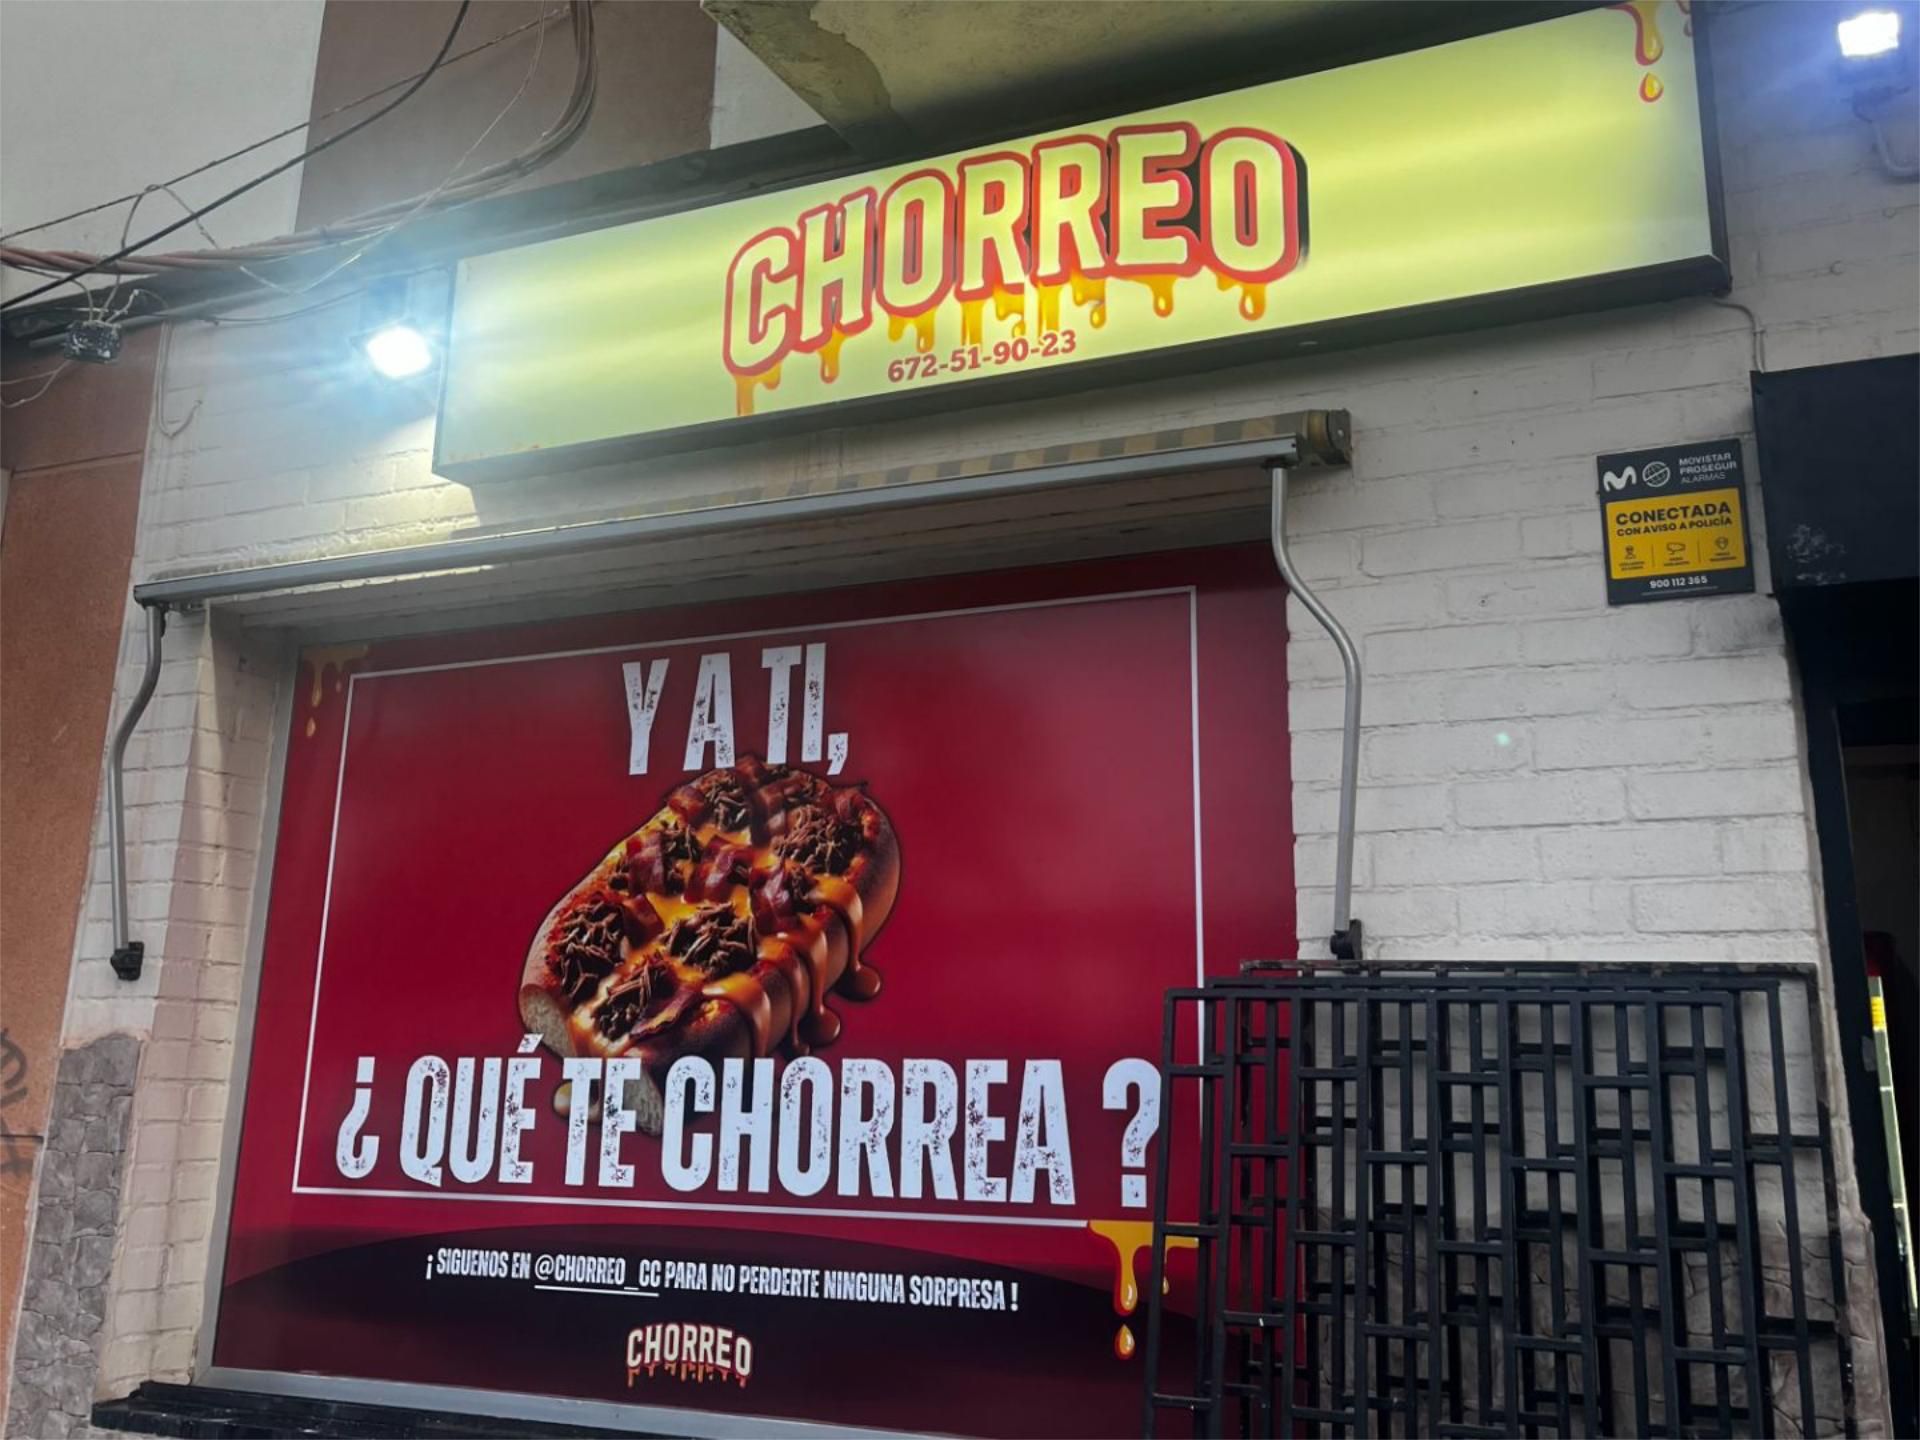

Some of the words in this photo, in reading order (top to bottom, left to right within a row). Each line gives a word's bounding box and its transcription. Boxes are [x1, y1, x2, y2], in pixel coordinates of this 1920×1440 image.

[723, 121, 1306, 377] CHORREO
[888, 329, 1077, 383] 672-51-90-23
[1679, 452, 1732, 466] MOVISTAR
[1680, 461, 1737, 475] PROSEGUR
[1681, 471, 1726, 483] ALARMAS
[1616, 502, 1731, 525] CONECTADA
[1616, 528, 1641, 537] CON
[1643, 522, 1676, 534] AVISO
[1679, 521, 1689, 530] A
[1689, 516, 1732, 528] POLICÍA
[1649, 579, 1670, 589] 900
[1672, 577, 1686, 586] 112
[1688, 575, 1708, 585] 365
[622, 659, 670, 775] Y
[683, 652, 735, 771] A
[761, 643, 849, 776] TI,
[400, 1033, 544, 1187] QUÉ
[563, 1057, 642, 1187] TE
[662, 1057, 1075, 1205] CHORREA
[436, 1248, 509, 1277] SIGUENOS
[511, 1252, 531, 1279] EN
[664, 1261, 707, 1291] PARA
[711, 1263, 735, 1293] NO
[738, 1265, 820, 1298] PERDERTE
[824, 1270, 905, 1304] NINGUNA
[909, 1275, 1006, 1310] SORPRESA
[625, 1321, 753, 1378] CHORREO
